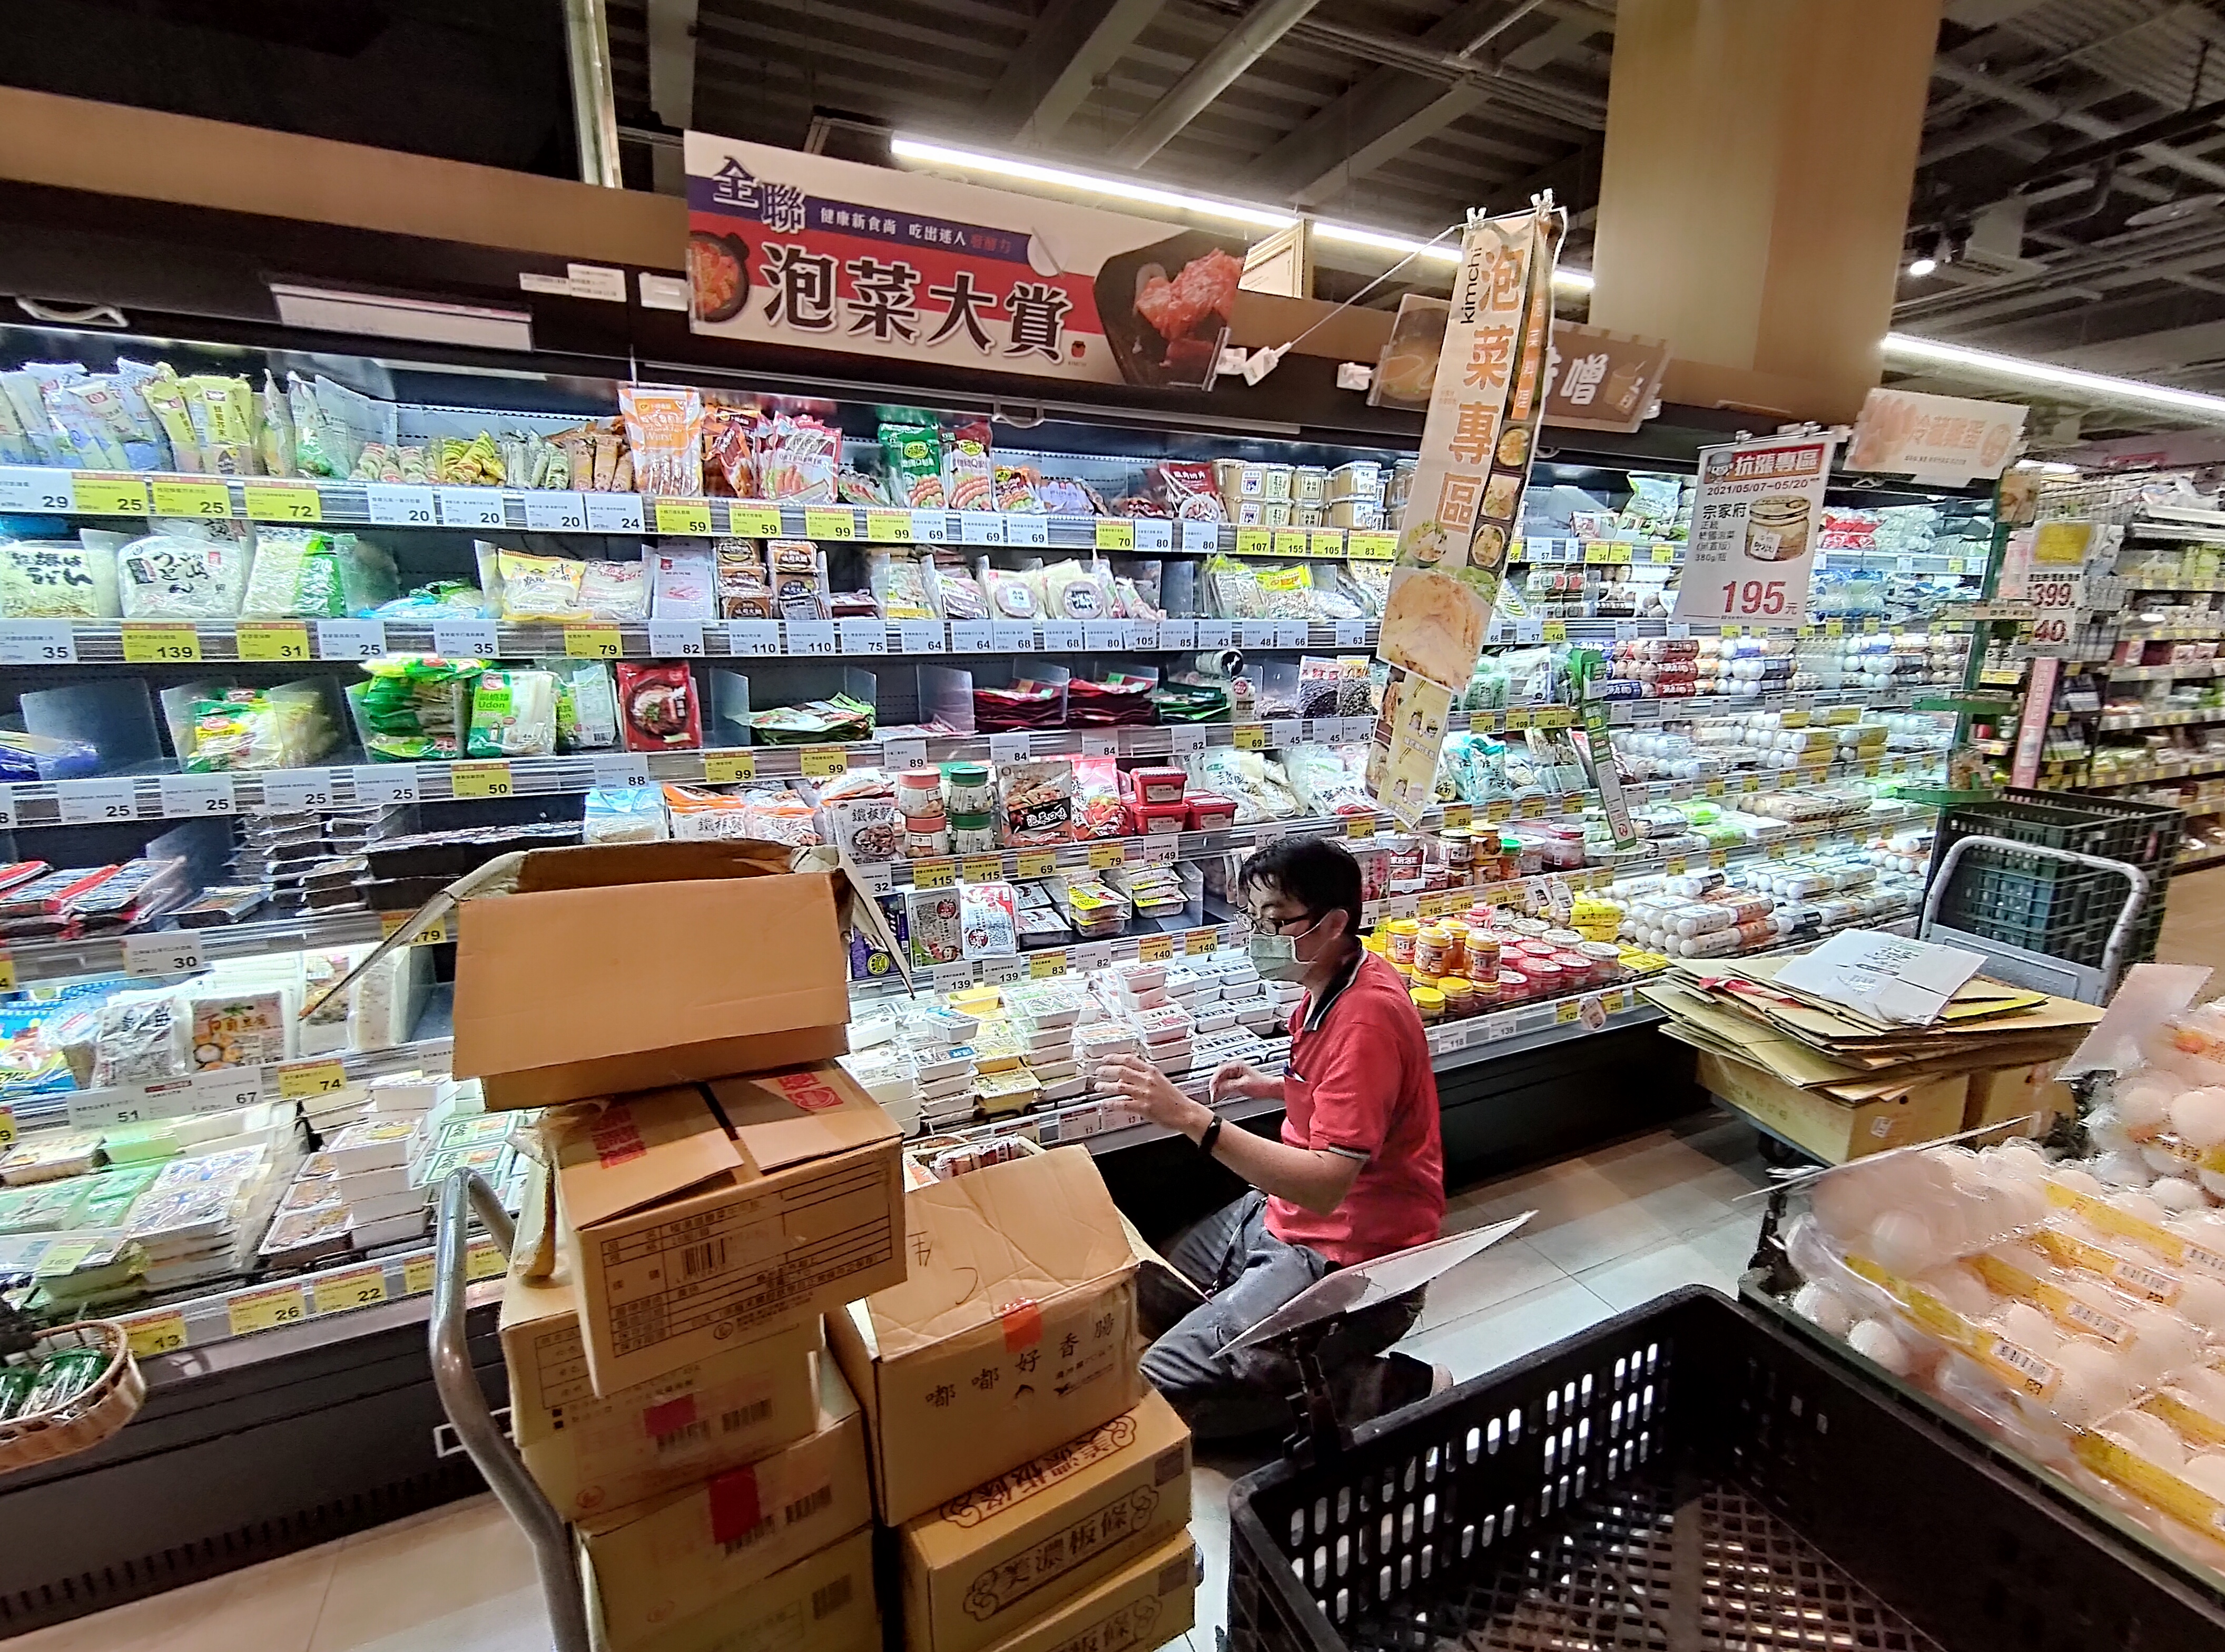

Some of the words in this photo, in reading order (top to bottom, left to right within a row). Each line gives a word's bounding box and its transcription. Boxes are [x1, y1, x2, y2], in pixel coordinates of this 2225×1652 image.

[713, 155, 806, 235] 全聯
[820, 207, 898, 235] 健康新食尚
[909, 222, 967, 247] 吃出迷人
[1460, 247, 1482, 324] kimchi
[759, 241, 1074, 365] 泡菜大賞
[1434, 243, 1525, 533] 泡菜專區
[1735, 449, 1822, 476] 抗漲專區
[42, 496, 68, 508] 29
[117, 499, 142, 510] 25
[200, 502, 224, 513] 25
[289, 506, 313, 517] 72
[1702, 502, 1747, 519] 宗家府
[409, 510, 429, 521] 20
[480, 513, 499, 523] 20
[562, 517, 579, 527] 20
[622, 518, 639, 528] 24
[690, 522, 706, 532] 59
[762, 525, 776, 534] 59
[835, 527, 850, 536] 99
[895, 529, 909, 538] 99
[929, 530, 943, 539] 69
[987, 533, 999, 541] 69
[1032, 534, 1044, 543] 69
[1119, 538, 1130, 546] 70
[1722, 580, 1786, 614] 195
[1785, 602, 1799, 615] 元
[2034, 583, 2072, 607] 399
[2034, 620, 2066, 642] 40
[928, 641, 941, 650] 64
[977, 641, 990, 649] 64
[1018, 640, 1030, 648] 68
[1136, 636, 1153, 646] 105
[281, 646, 301, 656] 31
[360, 645, 380, 655] 25
[475, 644, 493, 654] 35
[599, 645, 617, 654] 79
[683, 644, 700, 654] 82
[752, 644, 775, 653] 110
[809, 643, 831, 652] 110
[868, 642, 883, 651] 75
[43, 647, 68, 658] 35
[157, 647, 192, 657] 139
[1252, 739, 1262, 748] 69
[1104, 747, 1115, 755] 84
[1015, 752, 1027, 761] 84
[829, 764, 843, 773] 99
[910, 759, 923, 768] 89
[735, 770, 751, 779] 99
[628, 776, 645, 785] 88
[393, 789, 412, 799] 25
[489, 784, 507, 794] 50
[305, 793, 326, 804] 25
[206, 799, 228, 810] 25
[106, 805, 130, 817] 25
[1026, 807, 1068, 828] 泡菜口味
[1159, 852, 1175, 860] 149
[1041, 865, 1052, 874] 69
[932, 876, 952, 885] 115
[980, 871, 999, 880] 115
[875, 883, 889, 892] 32
[1199, 943, 1214, 952] 140
[1154, 950, 1170, 959] 140
[174, 957, 196, 968] 30
[1052, 966, 1064, 975] 83
[1000, 973, 1018, 982] 139
[951, 980, 970, 989] 139
[320, 1079, 341, 1090] 74
[236, 1092, 257, 1104] 67
[118, 1110, 138, 1122] 51
[358, 1288, 381, 1302] 22
[275, 1306, 299, 1321] 26
[925, 1312, 1116, 1410] 嘟嘟好香腸
